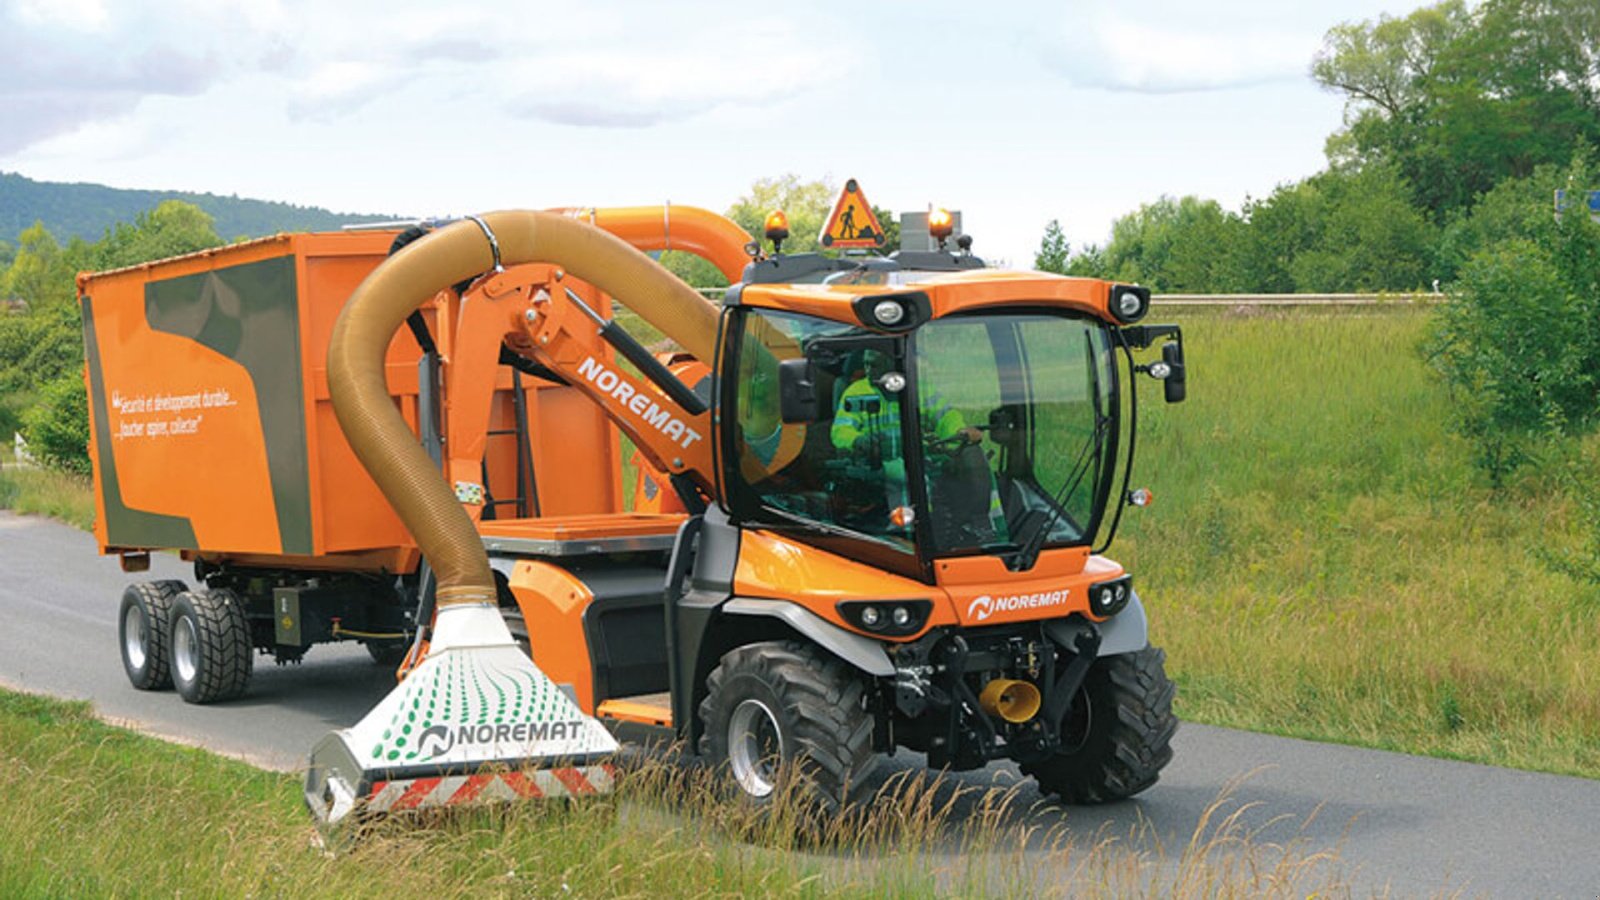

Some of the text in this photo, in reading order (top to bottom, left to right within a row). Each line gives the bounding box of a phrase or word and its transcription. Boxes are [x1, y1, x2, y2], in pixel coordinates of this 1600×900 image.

[577, 356, 702, 449] NOREMAT
[995, 589, 1071, 611] NOREMAT
[457, 721, 583, 745] NOREMAT
